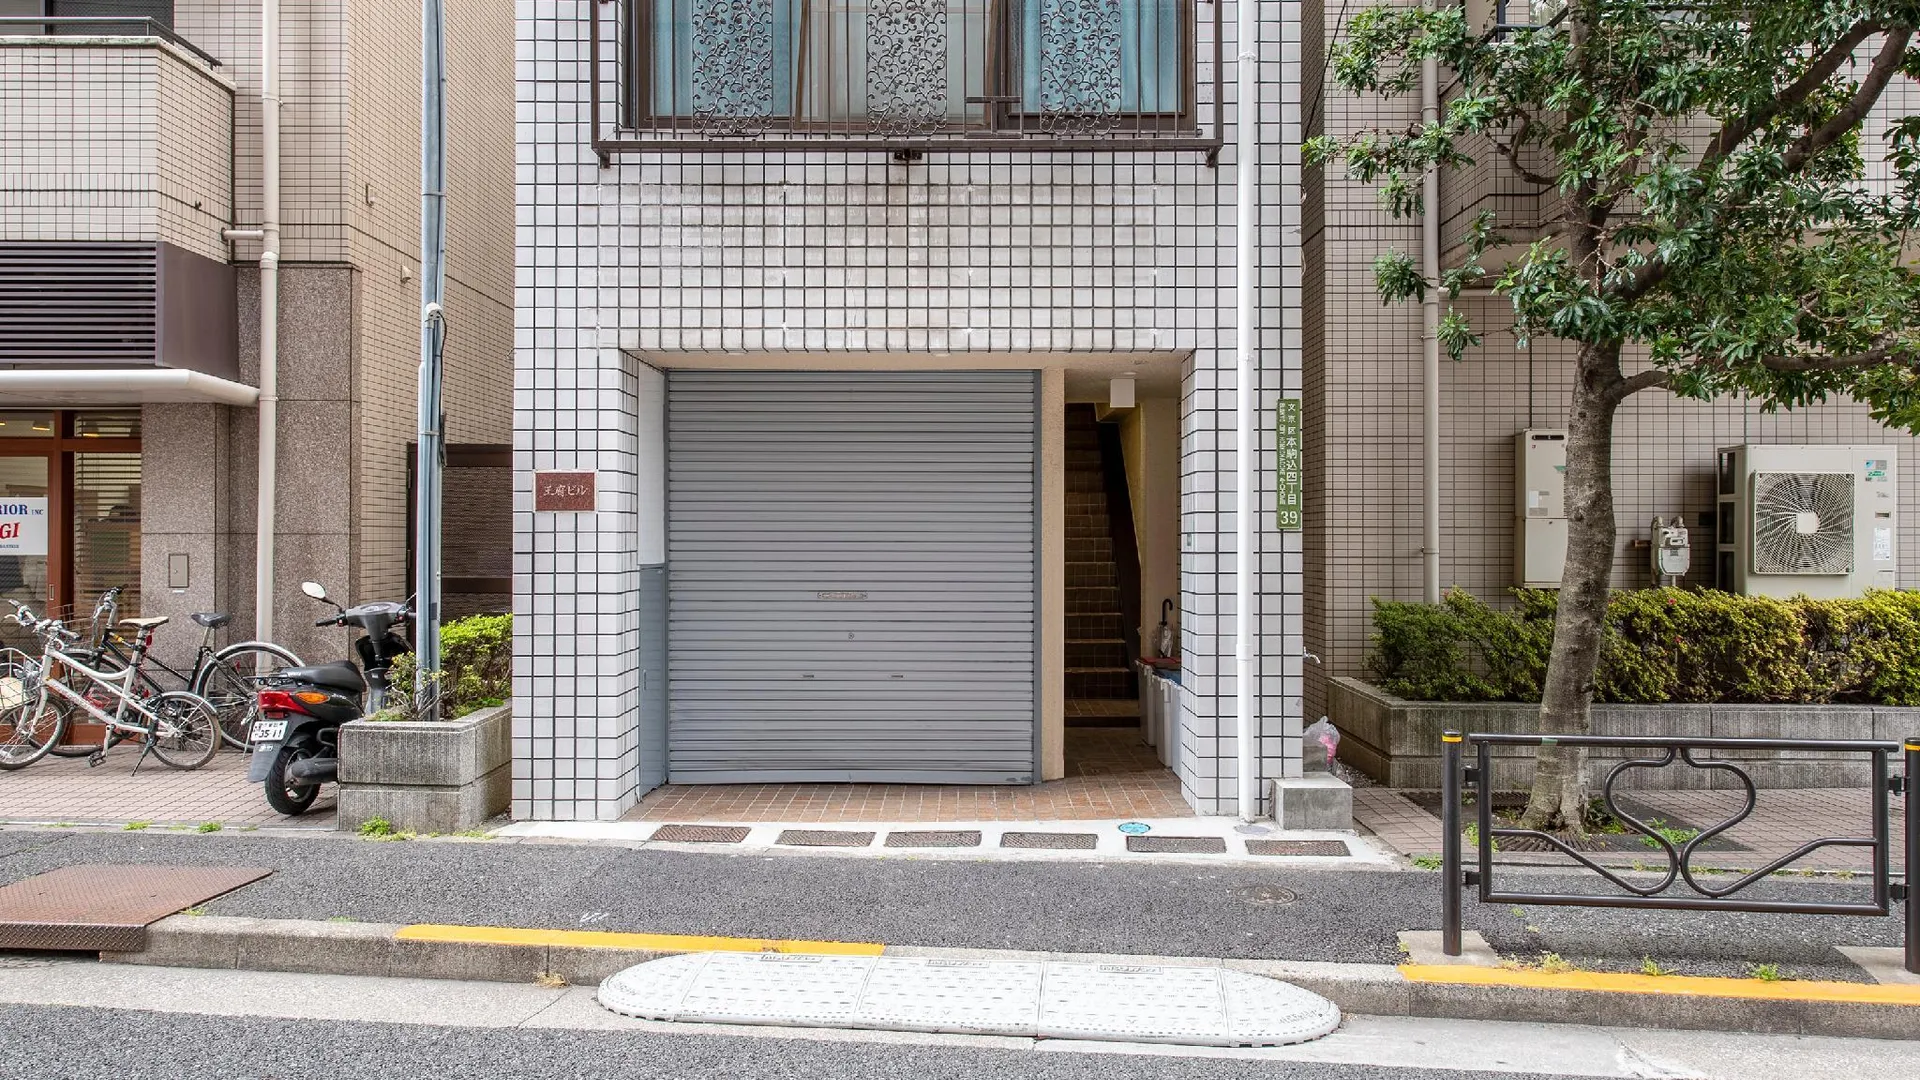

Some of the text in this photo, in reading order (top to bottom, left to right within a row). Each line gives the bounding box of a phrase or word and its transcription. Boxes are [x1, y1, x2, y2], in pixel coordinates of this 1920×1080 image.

[1286, 403, 1298, 505] 文京区本駒込四丁目
[0, 504, 28, 515] IOR
[1280, 510, 1298, 524] 39
